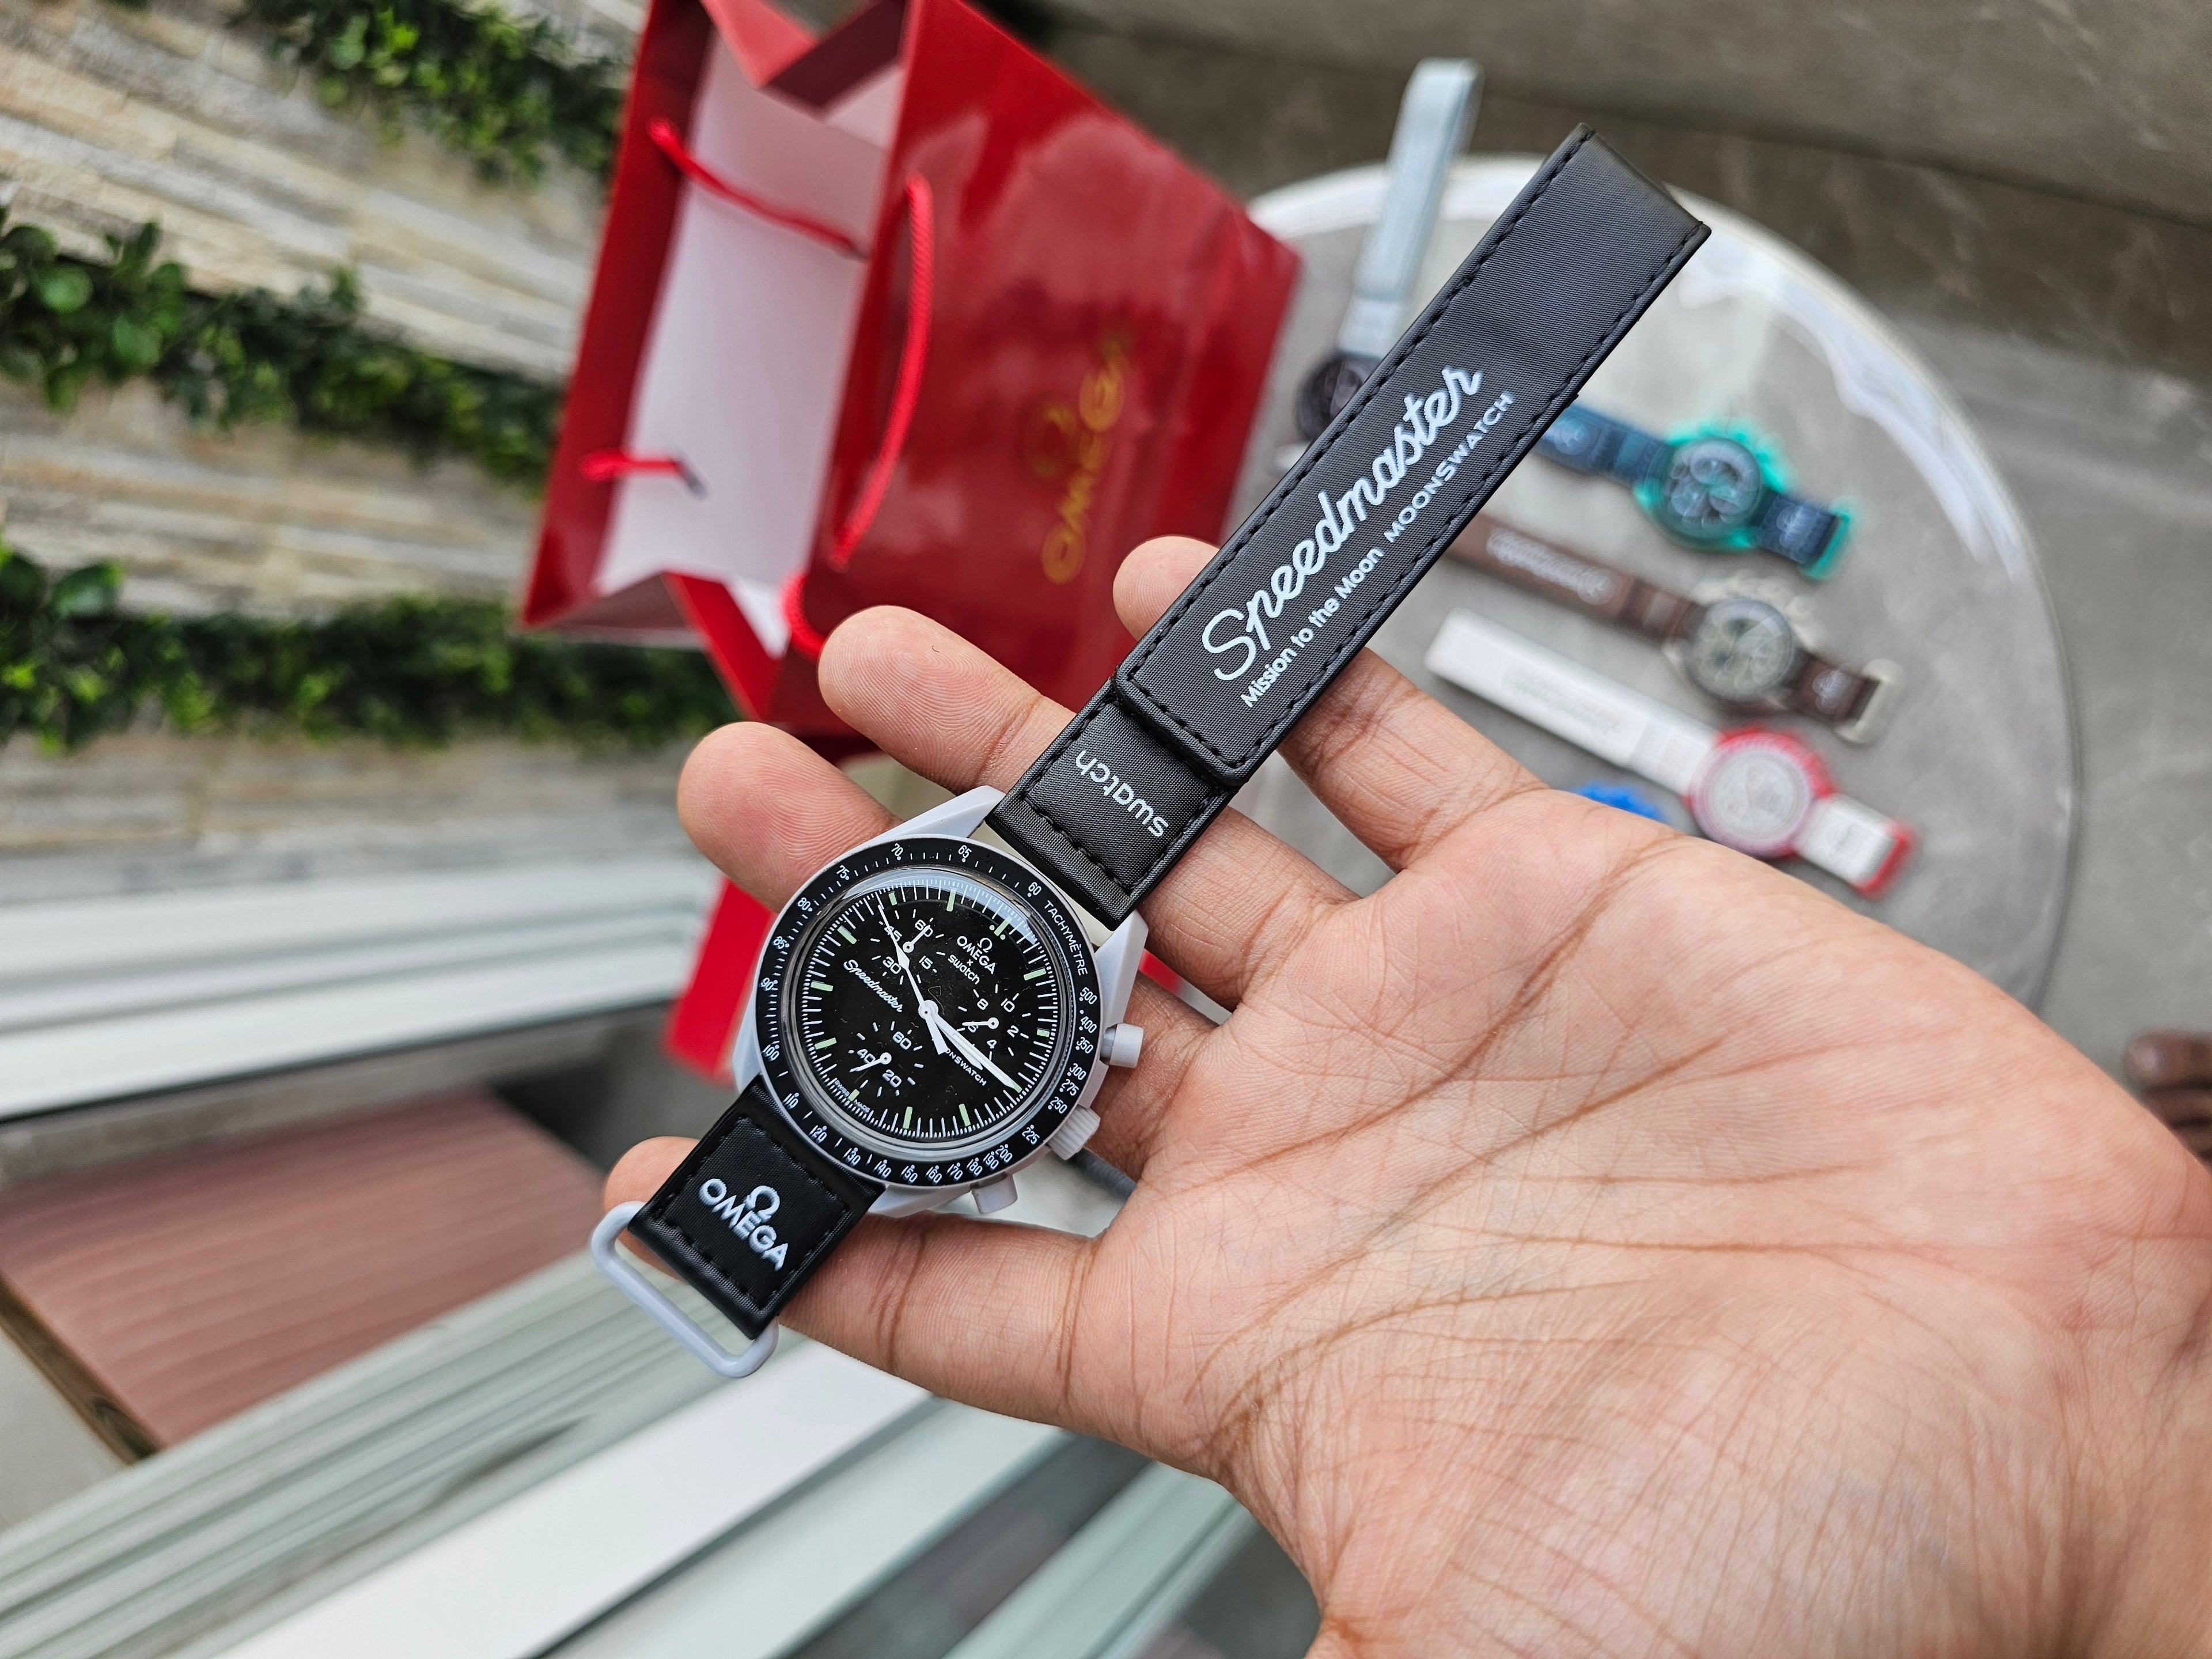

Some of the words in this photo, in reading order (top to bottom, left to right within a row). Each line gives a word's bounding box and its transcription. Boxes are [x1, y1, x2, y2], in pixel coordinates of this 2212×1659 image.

[1041, 331, 1130, 586] OMEG
[1202, 366, 1482, 681] Speedmaster
[1240, 649, 1297, 708] Mission
[1290, 627, 1314, 649] to
[1308, 597, 1340, 625] the
[1334, 547, 1384, 599] Moon
[1383, 391, 1514, 543] MOONSWATCH
[1075, 750, 1169, 838] swatch
[892, 843, 903, 857] 70
[957, 844, 972, 858] 65
[836, 865, 850, 879] 75
[1028, 881, 1041, 896] 60
[797, 897, 810, 911] 80
[915, 919, 933, 937] 60
[773, 935, 787, 949] 85
[1044, 900, 1088, 976] TACHYMÈTRE
[919, 955, 933, 969] 15
[957, 935, 996, 975] OMEGA
[882, 956, 902, 974] 30
[948, 954, 980, 984] swatch
[759, 978, 774, 991] 90
[843, 959, 903, 1013] Speedmaster
[976, 998, 988, 1010] 8
[1081, 987, 1098, 1005] 500
[1001, 998, 1015, 1013] 10
[1007, 1025, 1019, 1037] 2
[1080, 1016, 1097, 1033] 400
[892, 1031, 912, 1050] 60
[986, 1039, 997, 1049] 4
[1078, 1036, 1094, 1054] 350
[762, 1044, 779, 1062] 100
[857, 1048, 876, 1064] 40
[945, 1048, 987, 1086] ONSWATCH
[1070, 1063, 1086, 1080] 300
[882, 1069, 902, 1088] 20
[1061, 1078, 1080, 1096] 275
[783, 1093, 799, 1108] 110
[1050, 1096, 1067, 1114] 250
[810, 1125, 827, 1143] 120
[1021, 1129, 1040, 1144] 225
[843, 1147, 861, 1166] 130
[983, 1153, 999, 1170] 190
[995, 1146, 1013, 1163] 200
[874, 1161, 892, 1179] 140
[900, 1165, 918, 1184] 150
[925, 1166, 942, 1184] 160
[946, 1164, 963, 1181] 170
[967, 1158, 983, 1176] 180
[698, 1178, 789, 1272] OMEGA
